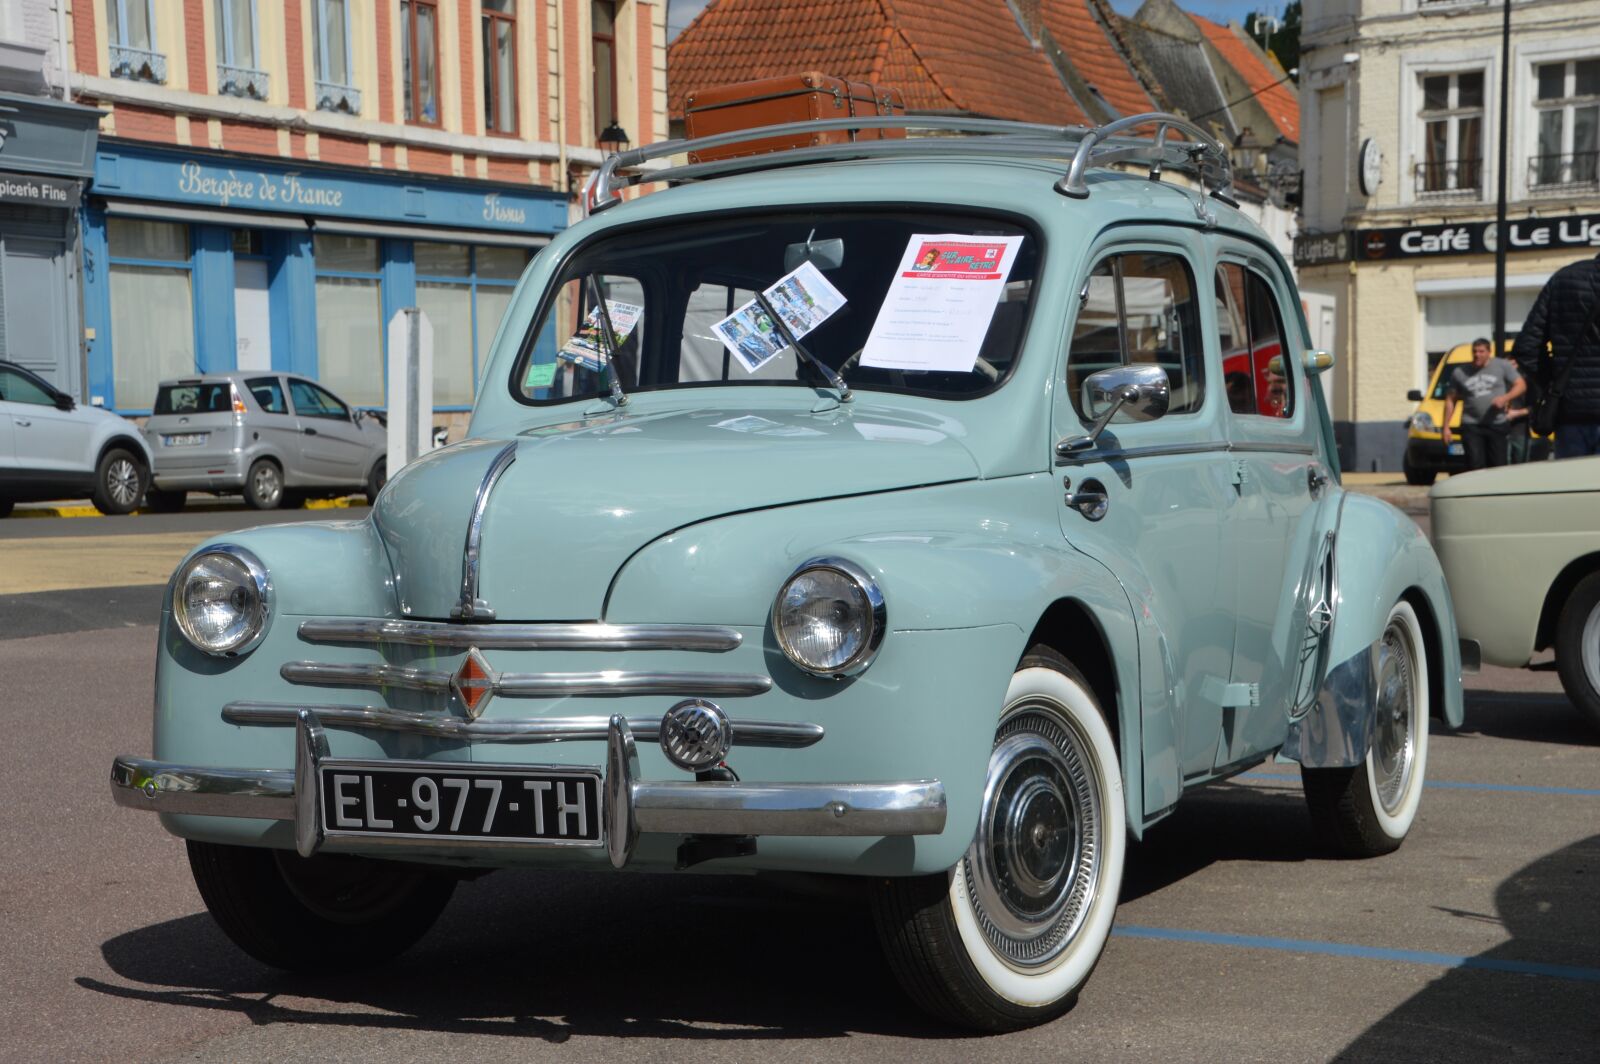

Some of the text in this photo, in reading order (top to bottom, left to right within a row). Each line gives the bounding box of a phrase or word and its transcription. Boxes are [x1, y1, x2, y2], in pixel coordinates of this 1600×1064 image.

[41, 184, 67, 201] Fine
[178, 160, 343, 207] Bergère de France
[483, 193, 526, 224] Tissus
[1400, 228, 1470, 253] Café
[1509, 224, 1550, 246] Le
[333, 774, 588, 837] EL-977-TH
